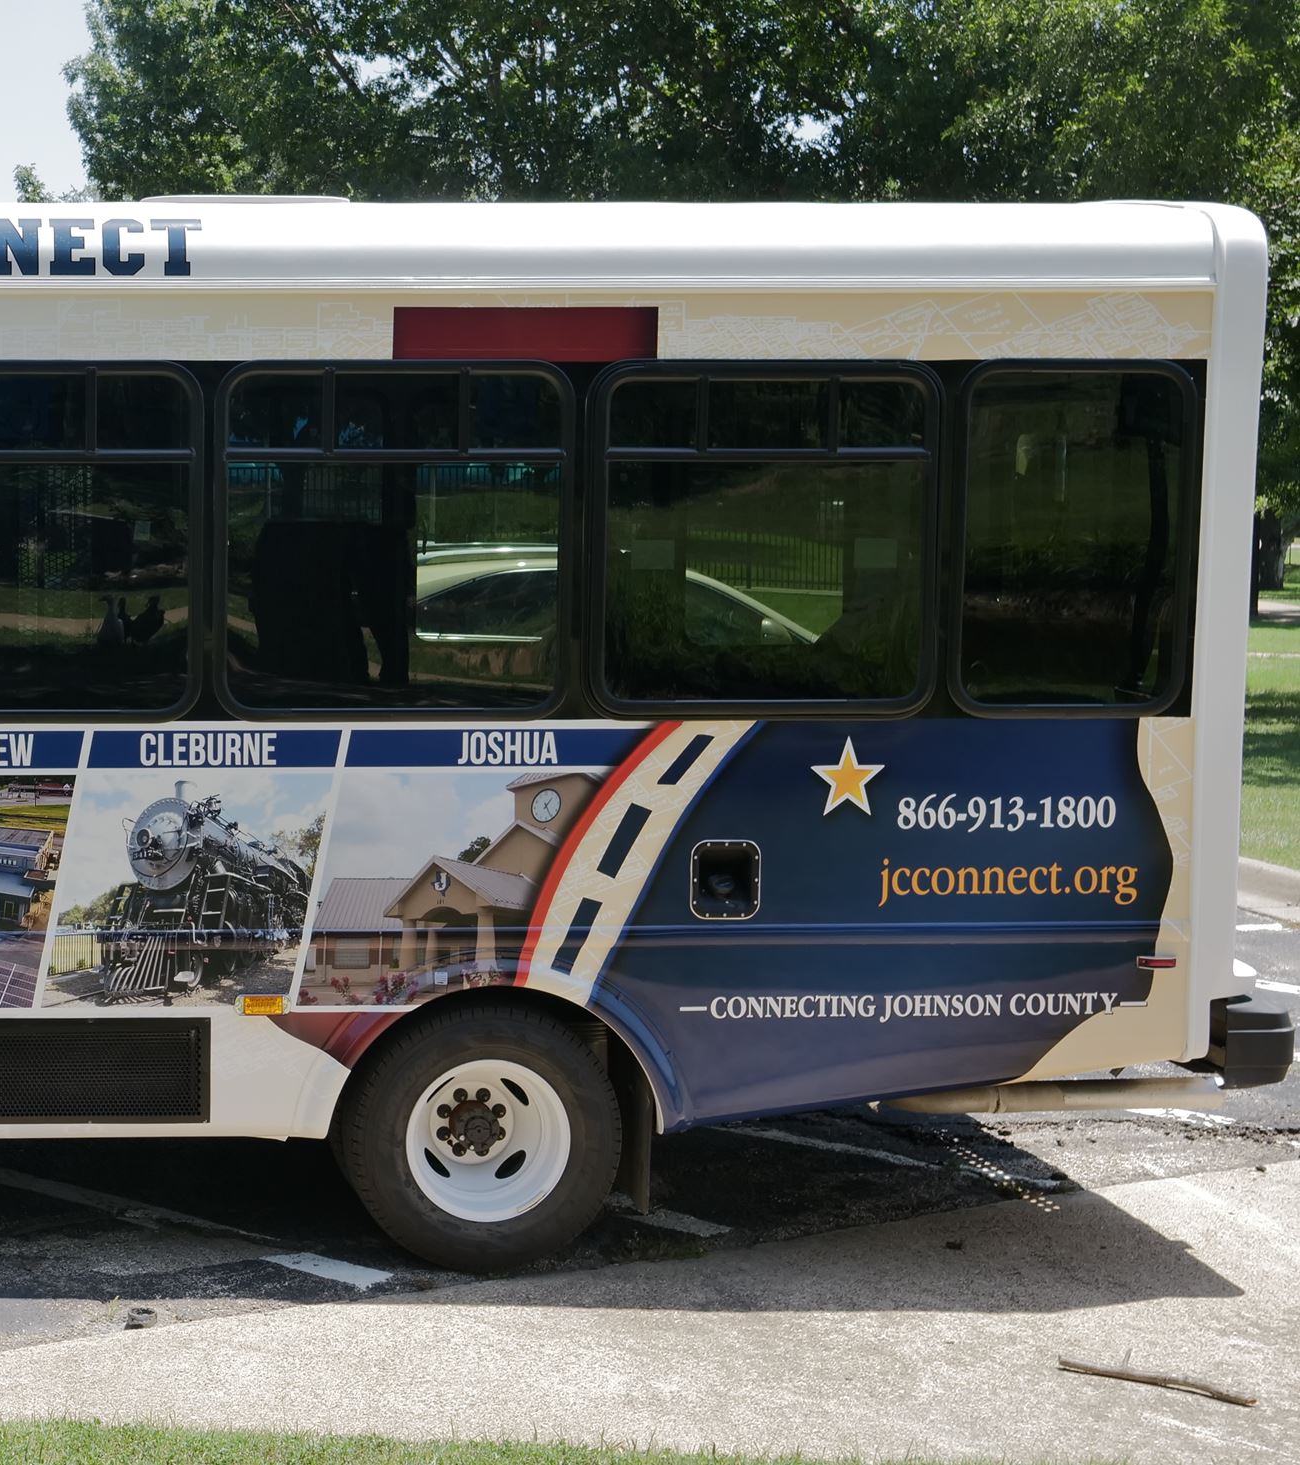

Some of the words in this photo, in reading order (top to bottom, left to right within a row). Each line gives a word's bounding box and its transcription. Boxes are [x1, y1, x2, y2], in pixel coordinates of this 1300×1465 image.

[139, 732, 277, 767] CLEBURNE
[457, 730, 558, 766] JOSHUA
[897, 793, 1117, 832] 866-913-1800
[878, 858, 1138, 907] jcconnect.org
[710, 994, 877, 1020] CONNECTING
[879, 993, 1002, 1023] JOHNSON
[1009, 991, 1118, 1018] COUNTY
